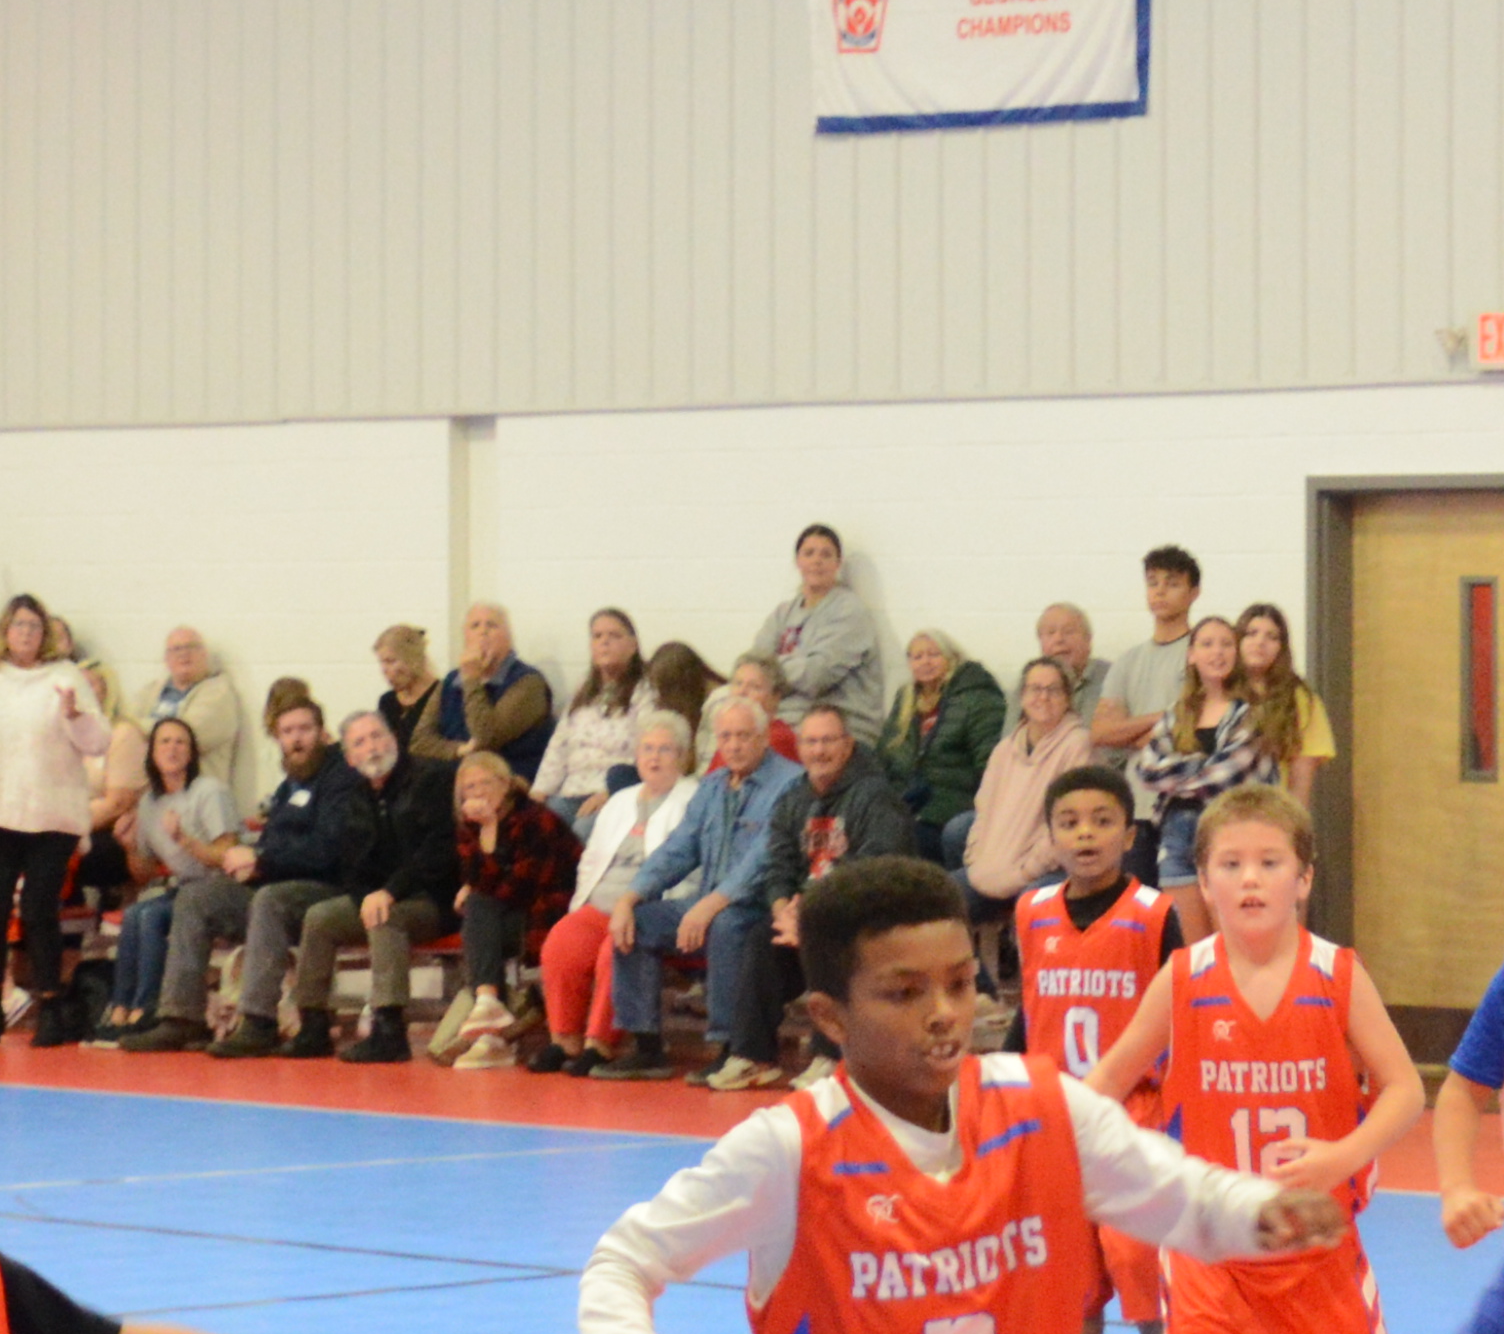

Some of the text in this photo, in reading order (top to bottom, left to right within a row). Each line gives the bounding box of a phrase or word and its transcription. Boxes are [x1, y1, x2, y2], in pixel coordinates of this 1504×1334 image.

[957, 11, 1071, 40] CHAMPIONS
[1037, 969, 1136, 998] PATRIOTS
[1065, 1006, 1099, 1078] 0
[1200, 1057, 1326, 1094] PATRIOTS
[850, 1214, 1048, 1300] PATRIOTS
